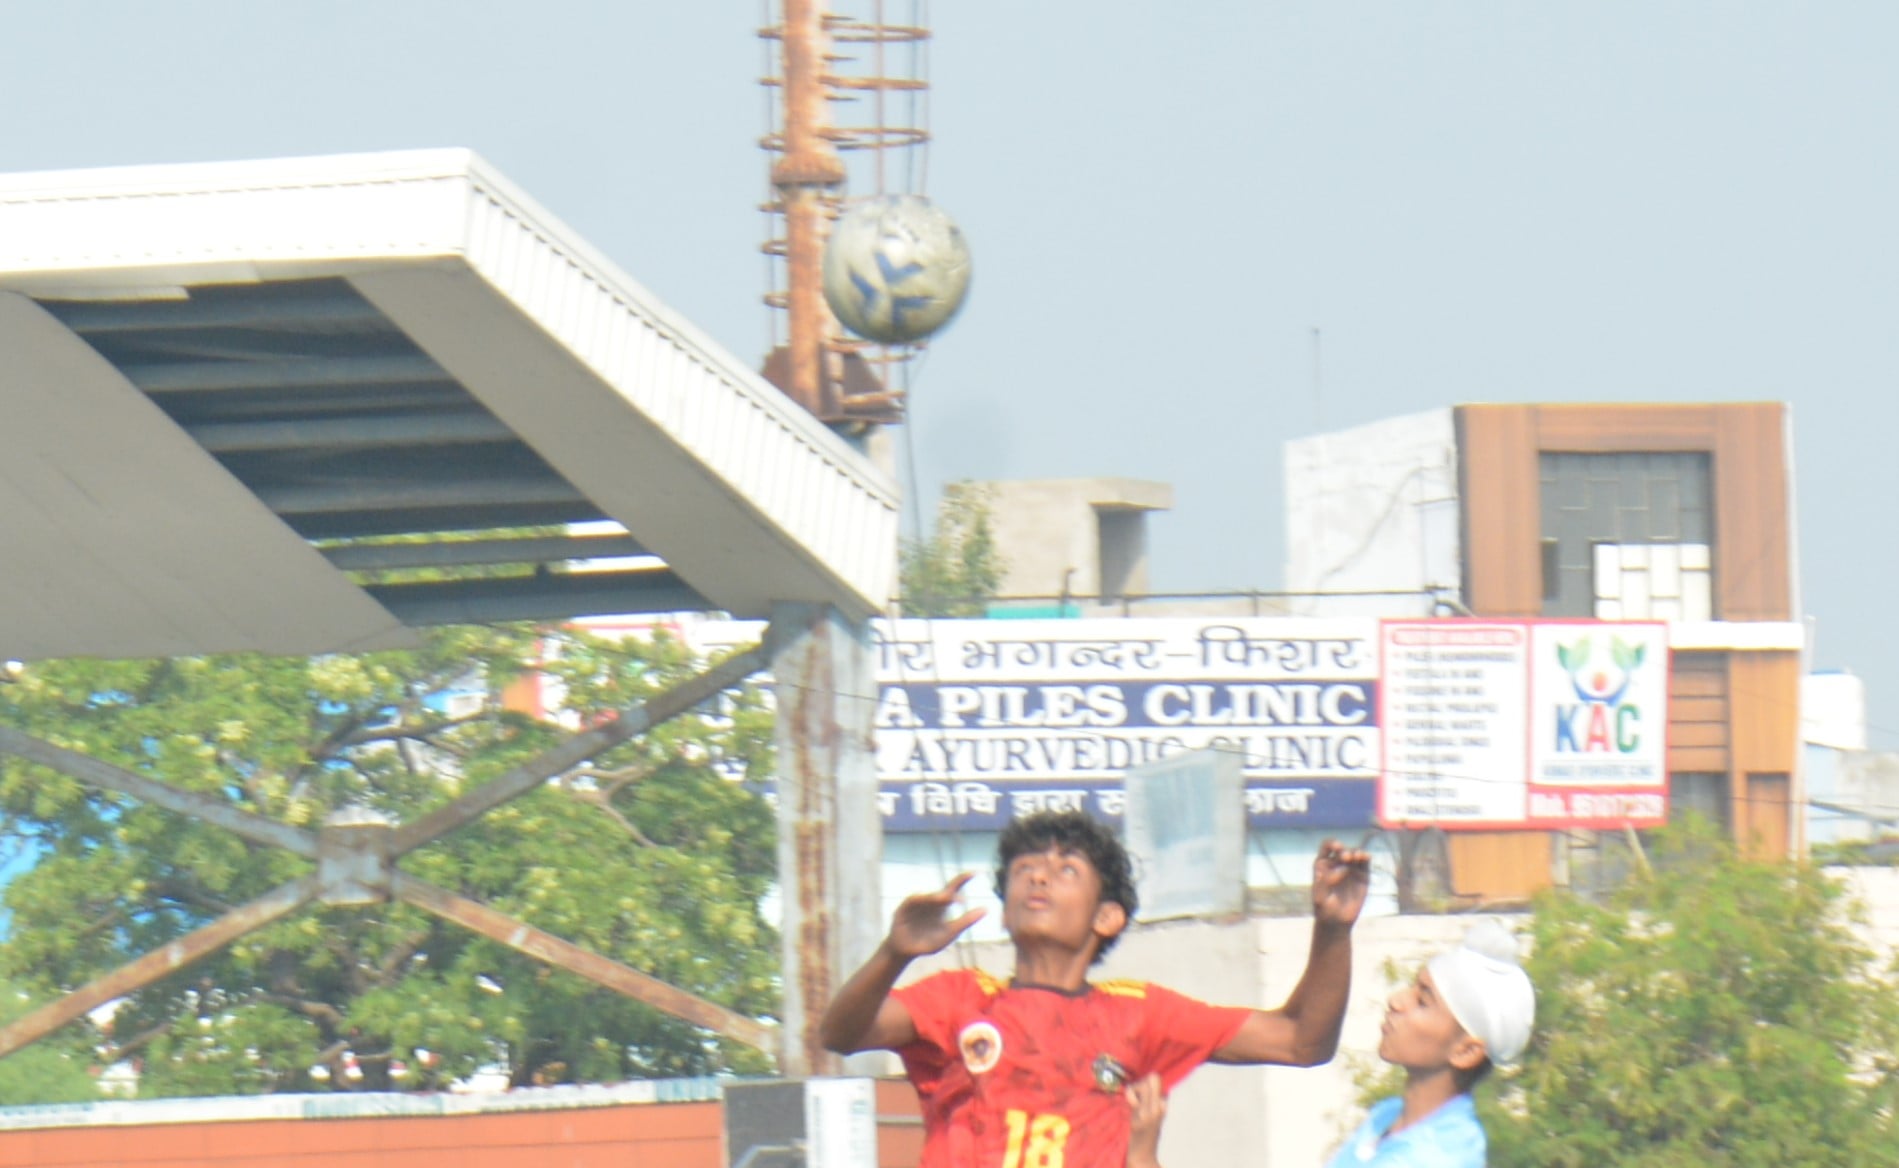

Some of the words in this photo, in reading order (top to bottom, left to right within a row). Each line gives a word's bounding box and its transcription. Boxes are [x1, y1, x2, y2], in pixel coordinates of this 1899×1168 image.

[937, 684, 1128, 726] PILES
[1142, 684, 1367, 726] CLINIC
[1556, 702, 1640, 753] KAC
